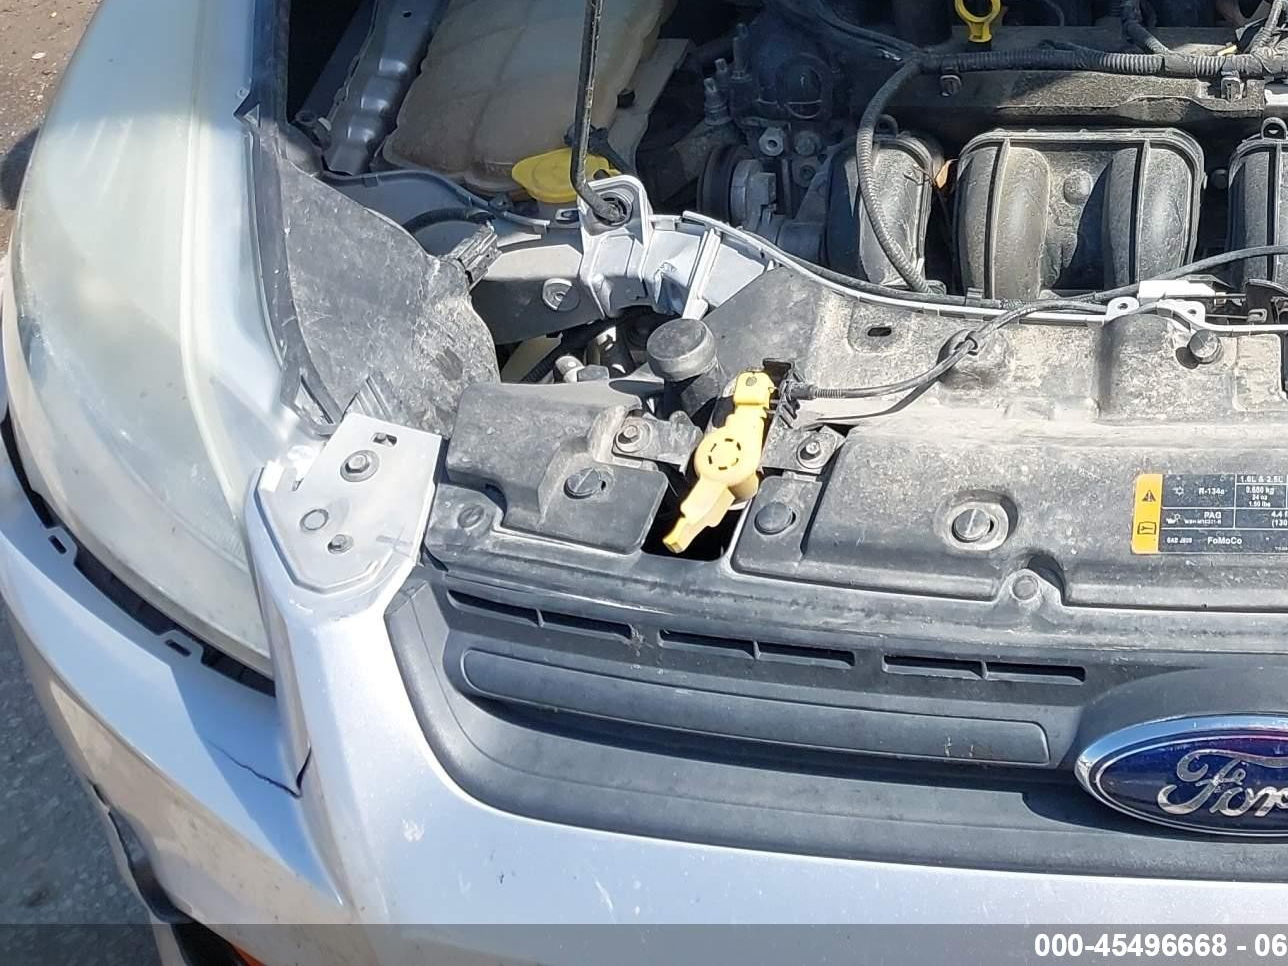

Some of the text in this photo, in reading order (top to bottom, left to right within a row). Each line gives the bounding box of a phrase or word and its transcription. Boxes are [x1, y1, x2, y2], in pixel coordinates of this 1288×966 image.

[1198, 487, 1225, 495] R-134a
[1204, 511, 1222, 519] PAG
[1207, 536, 1243, 545] FoMoCo
